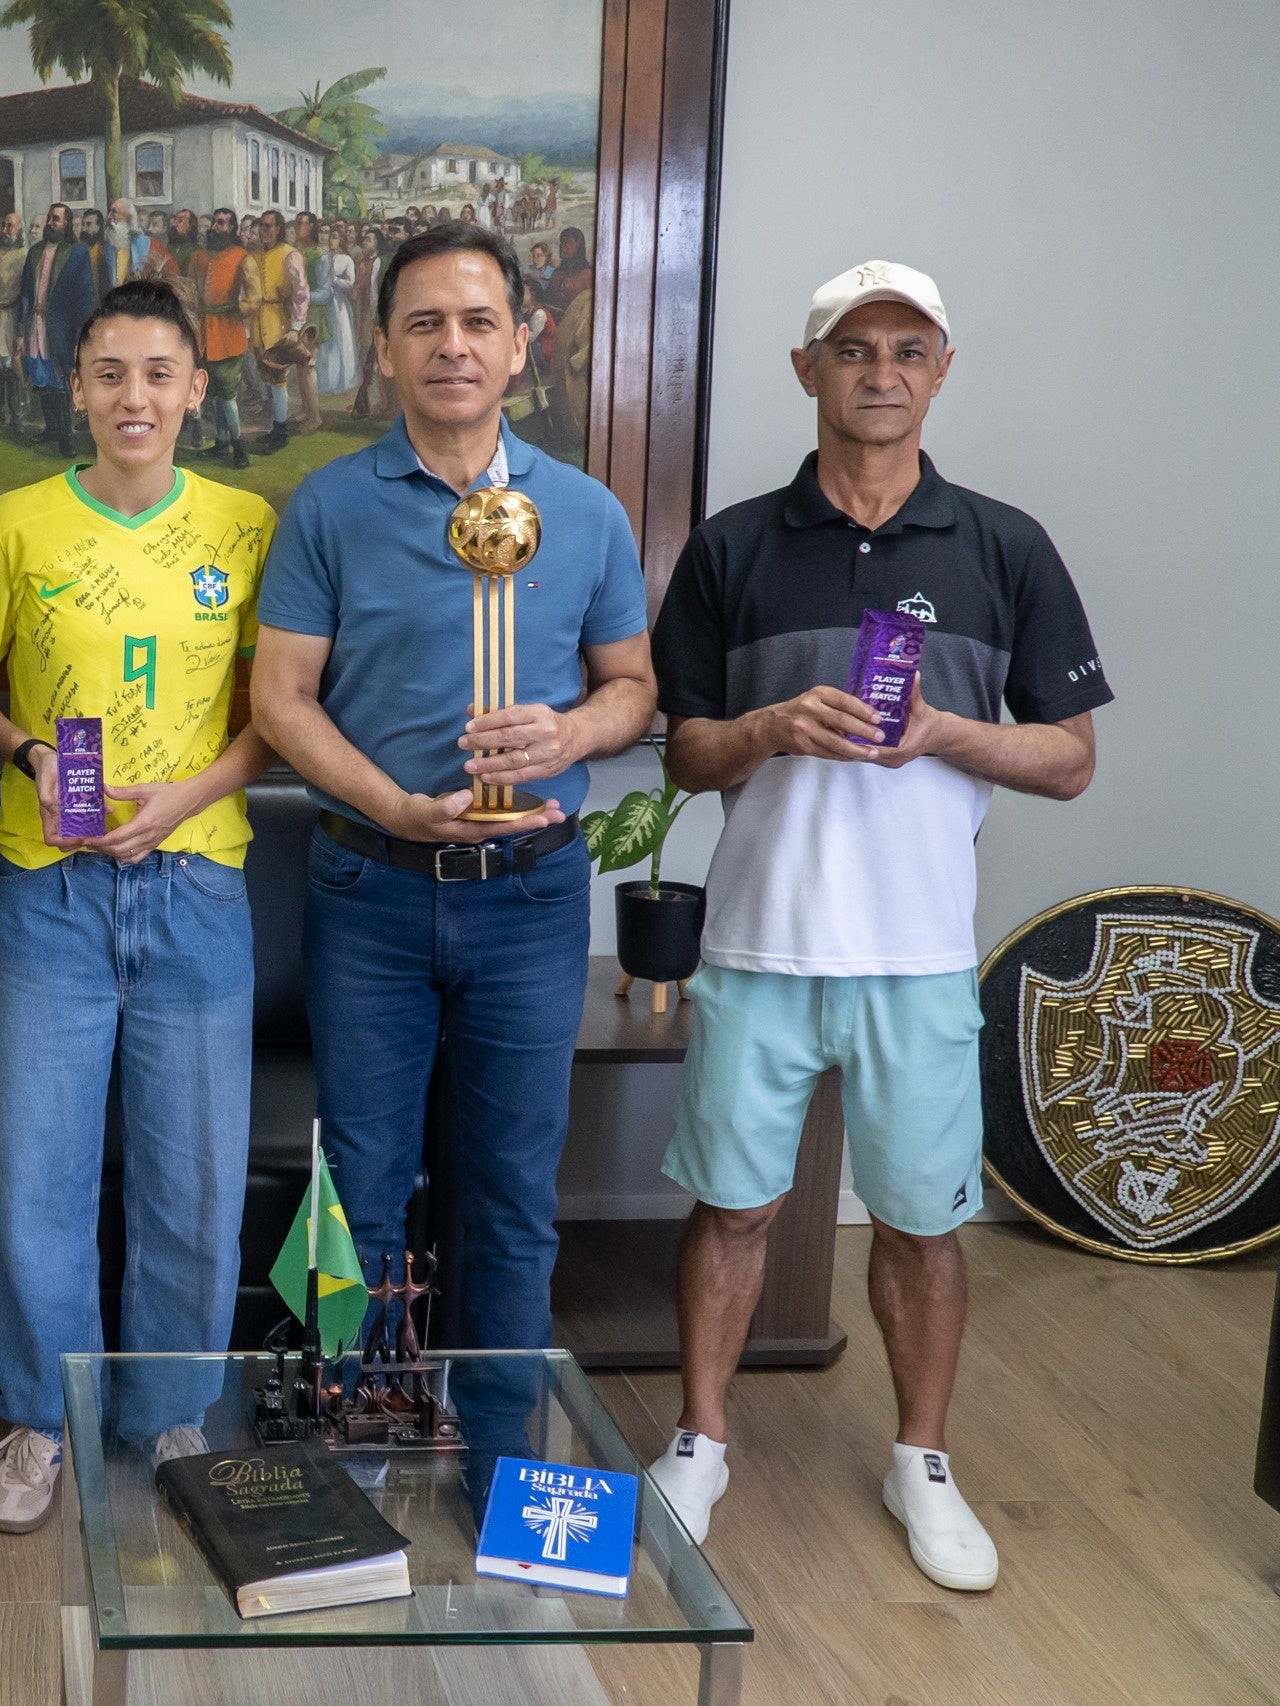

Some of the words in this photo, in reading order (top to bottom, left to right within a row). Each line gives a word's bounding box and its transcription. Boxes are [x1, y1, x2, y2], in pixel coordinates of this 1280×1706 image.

[124, 634, 156, 710] 9
[873, 675, 905, 685] PLAYER
[872, 683, 885, 691] OF
[885, 684, 903, 693] THE
[869, 692, 901, 702] MATCH
[226, 1477, 304, 1497] Sagrada
[519, 1468, 613, 1494] BÍBLIA
